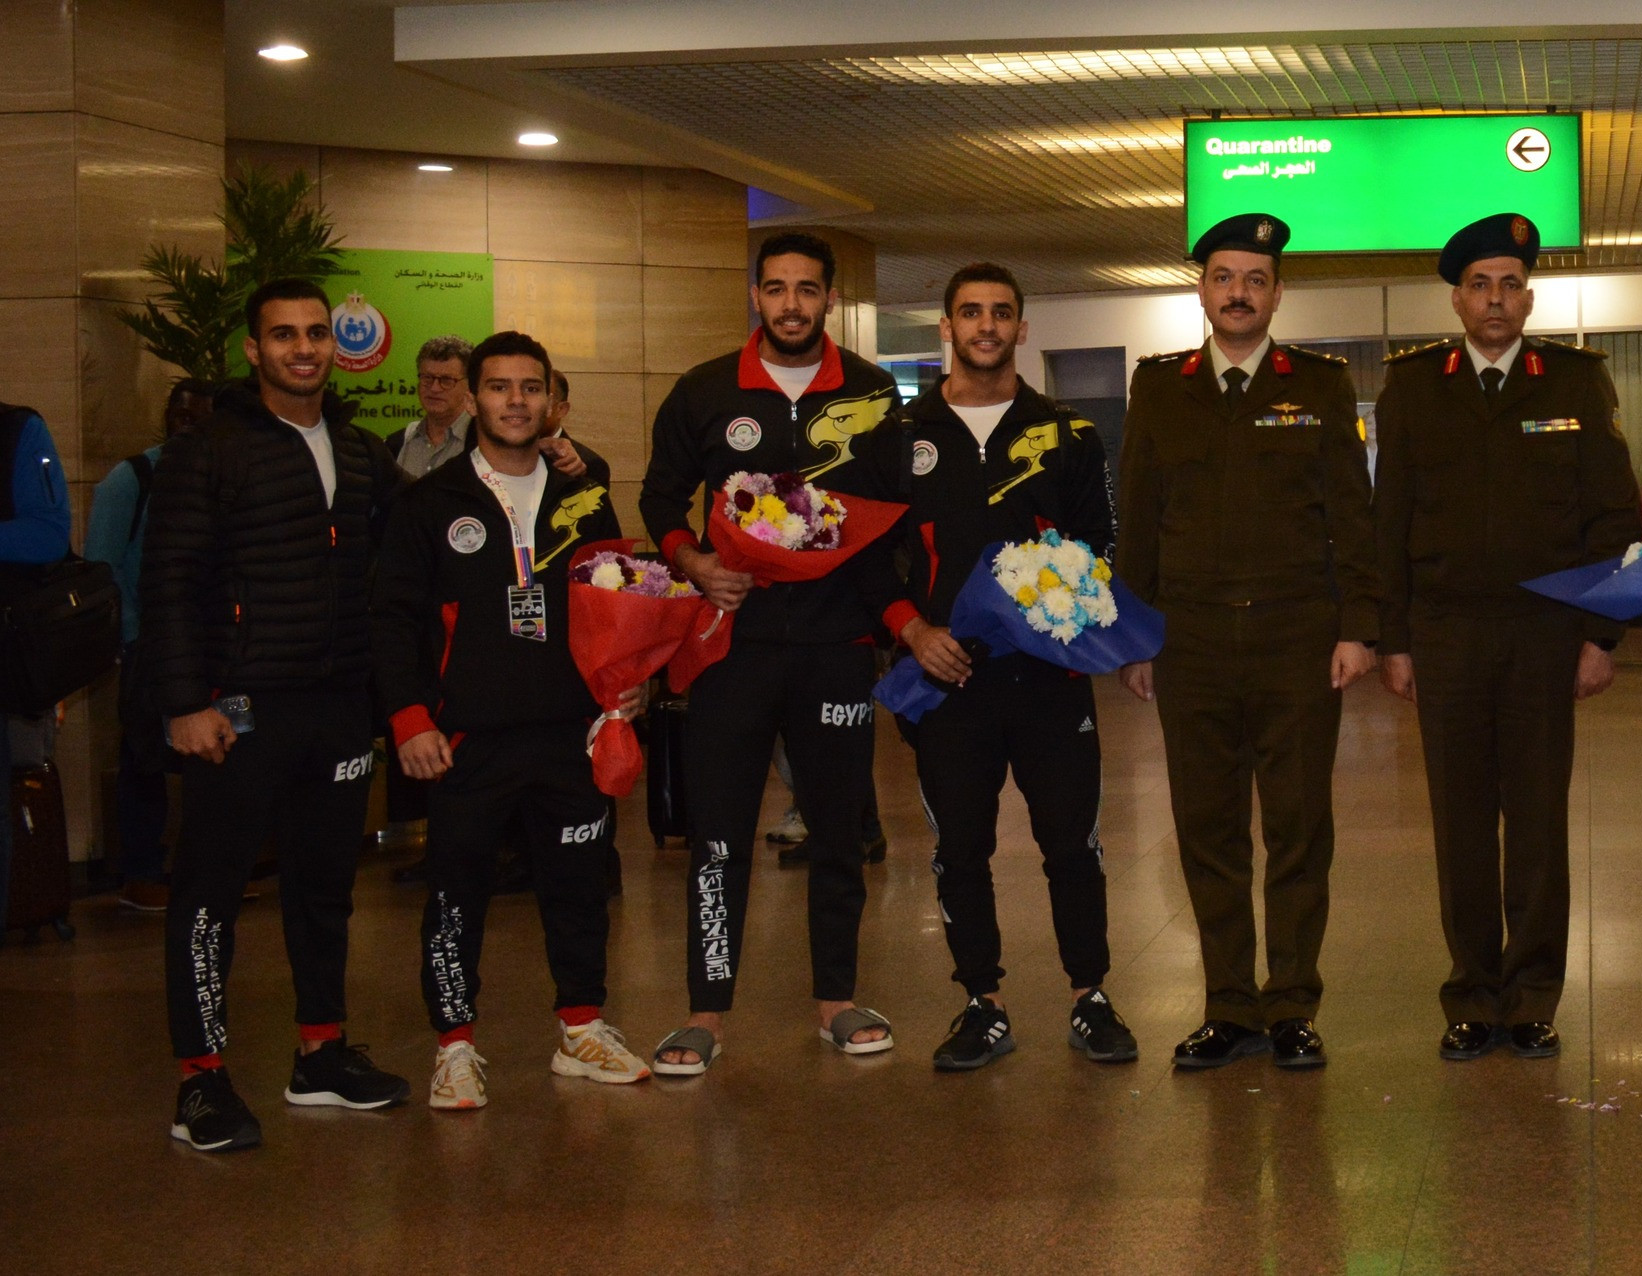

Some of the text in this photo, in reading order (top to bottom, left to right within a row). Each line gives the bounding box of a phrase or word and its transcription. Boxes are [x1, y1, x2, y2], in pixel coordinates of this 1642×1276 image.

[1206, 135, 1332, 156] Quarantine
[1271, 160, 1316, 179] الحجر
[342, 379, 393, 399] الحجر
[382, 404, 424, 418] Clinic
